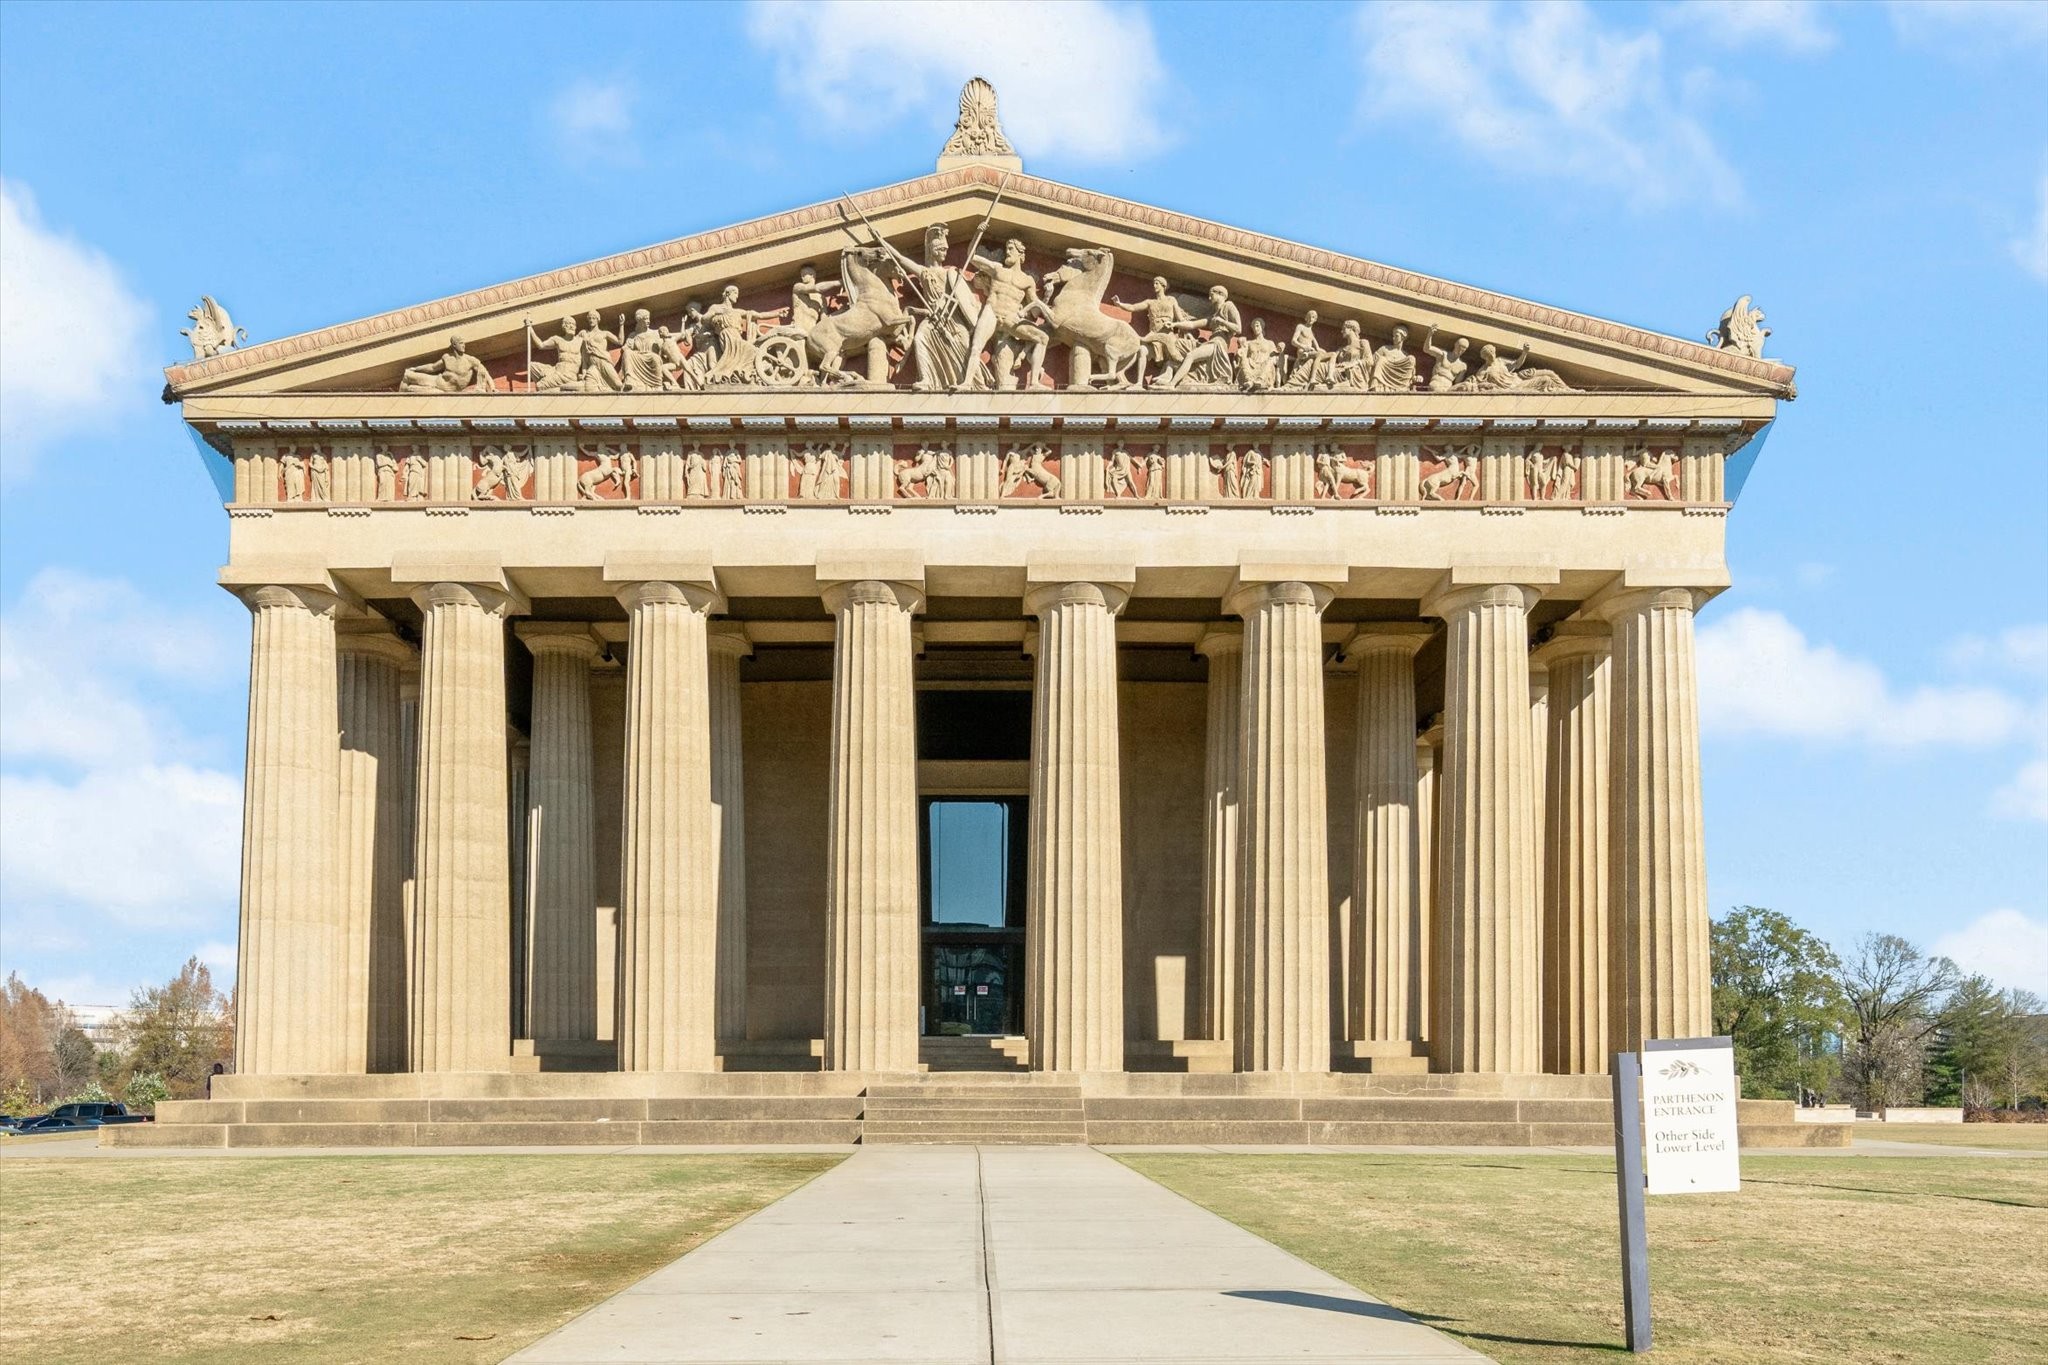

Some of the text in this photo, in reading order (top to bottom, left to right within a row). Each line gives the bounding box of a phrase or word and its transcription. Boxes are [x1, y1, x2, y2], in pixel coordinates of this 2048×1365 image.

[1653, 1092, 1724, 1105] PARTHENON
[1654, 1105, 1716, 1117] ENTRANCE
[1655, 1128, 1715, 1142] Other Side
[1656, 1139, 1725, 1154] Lower Level
